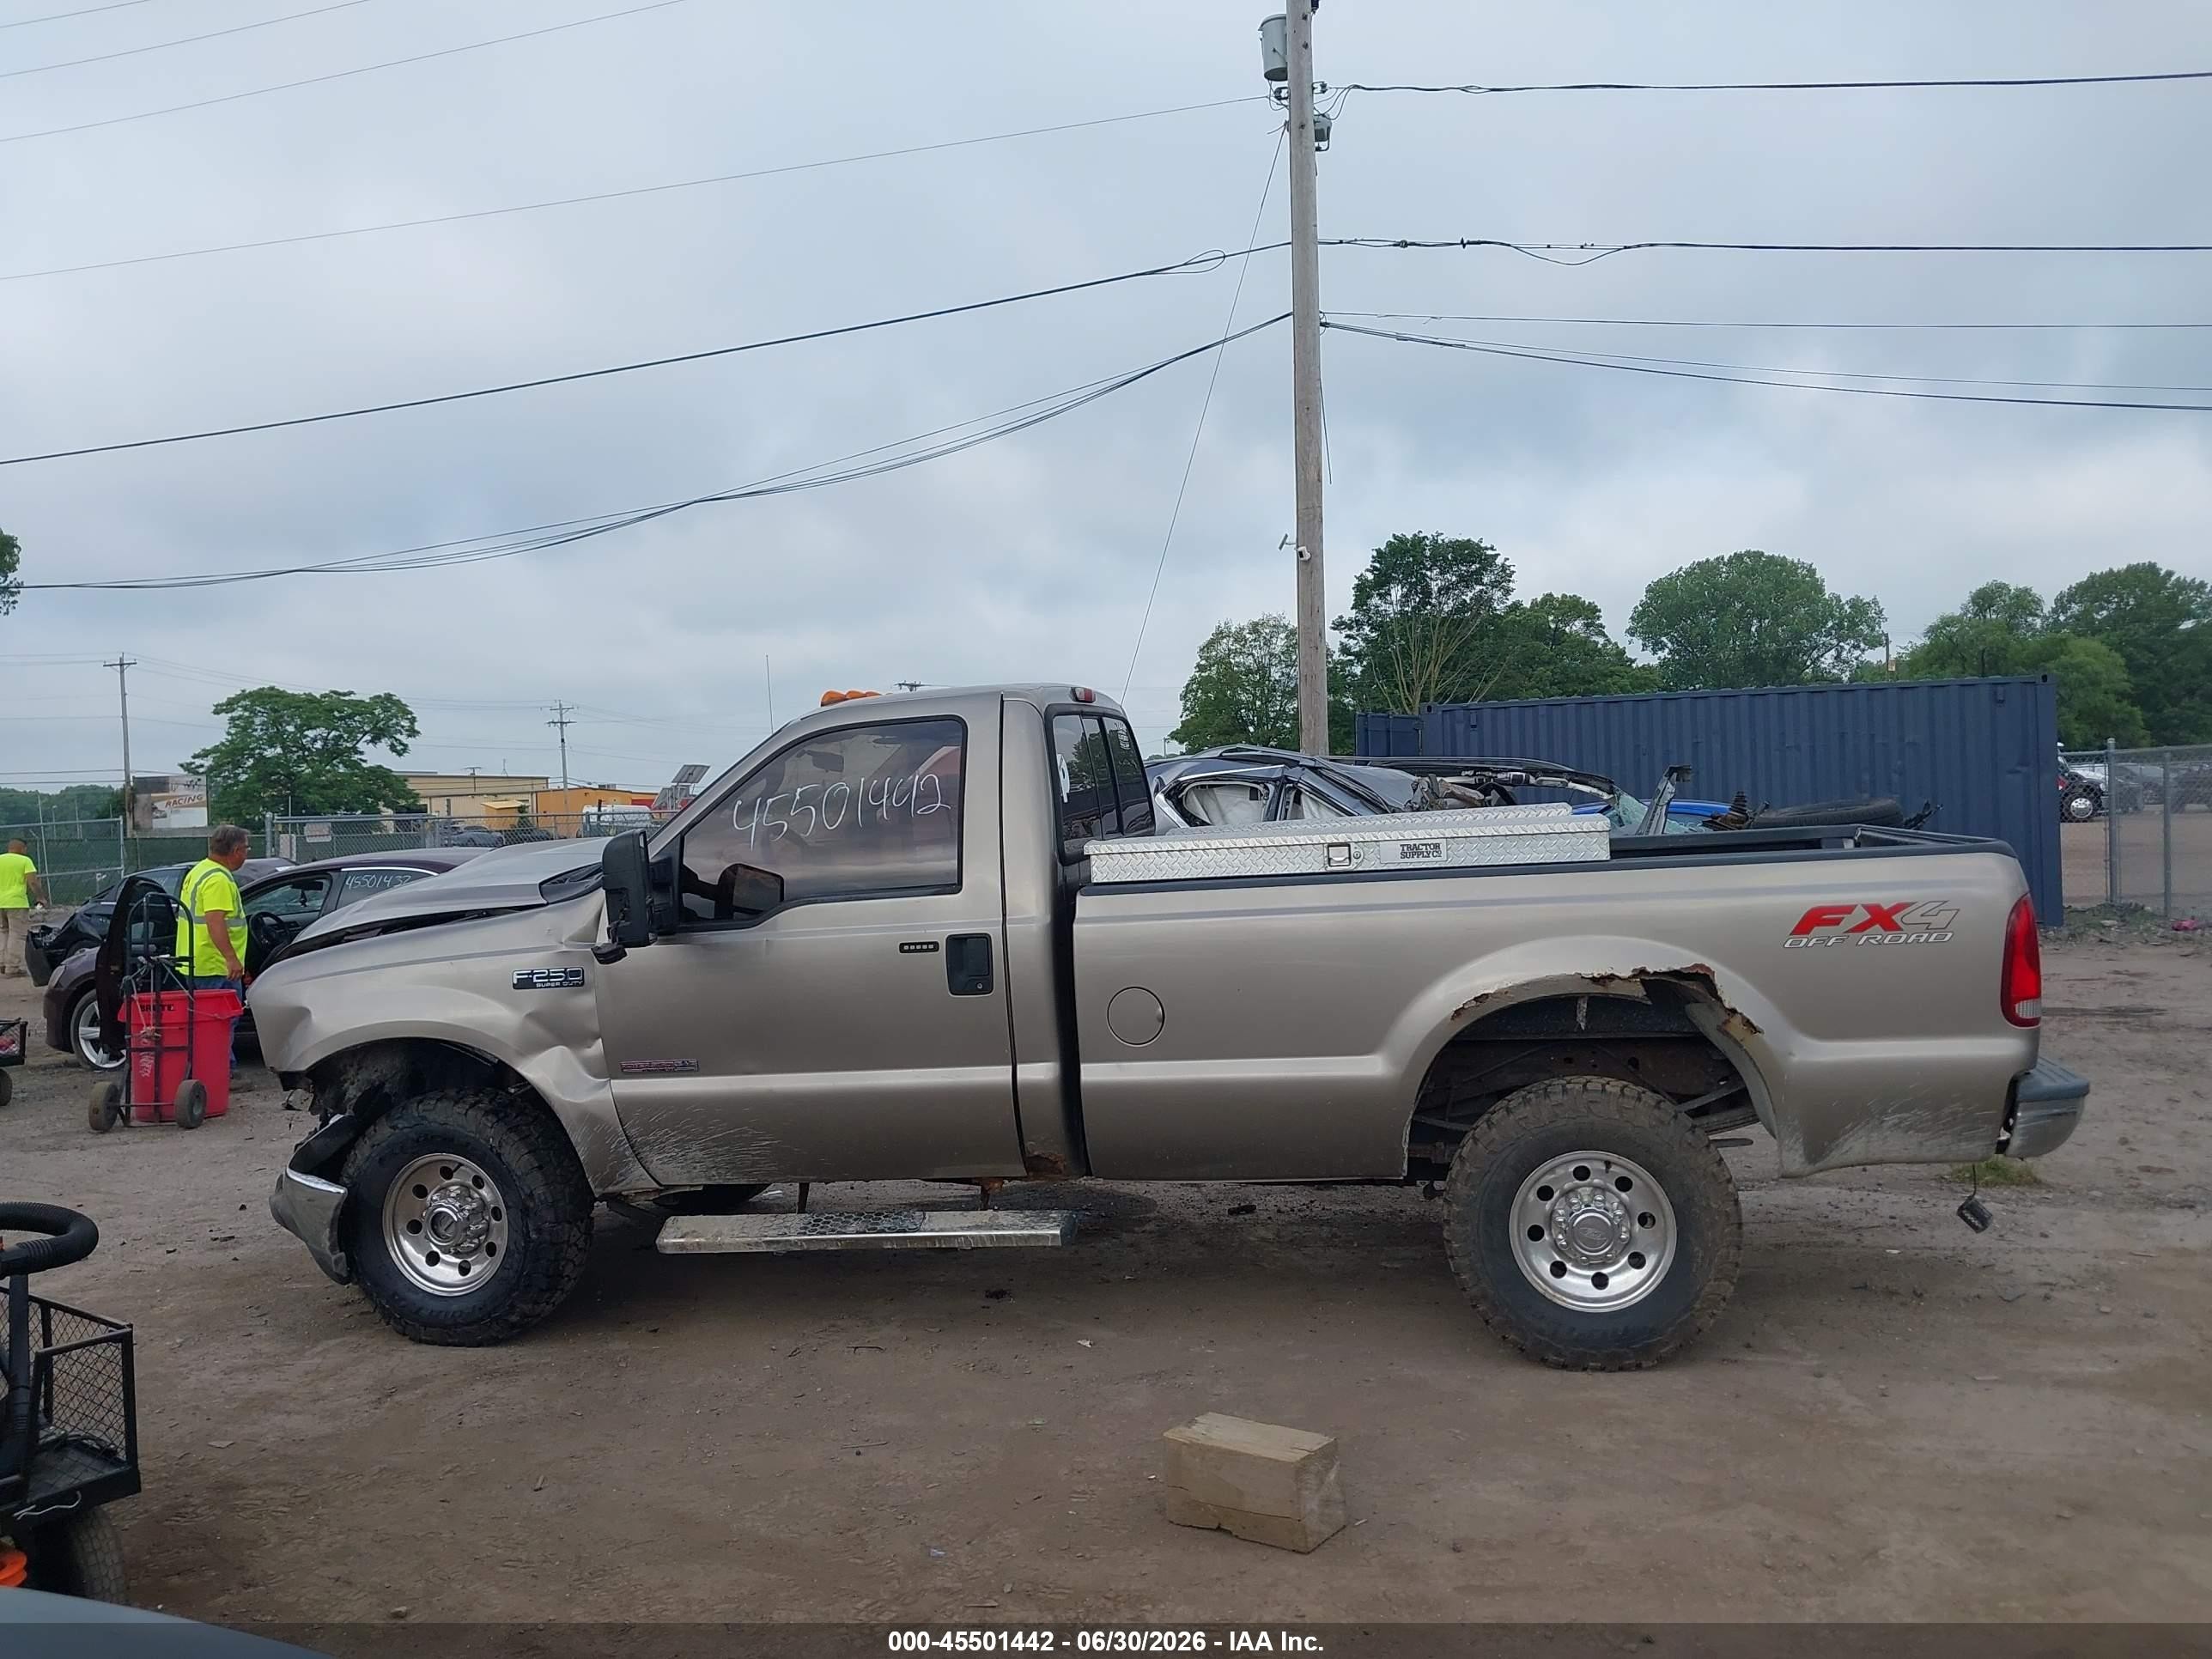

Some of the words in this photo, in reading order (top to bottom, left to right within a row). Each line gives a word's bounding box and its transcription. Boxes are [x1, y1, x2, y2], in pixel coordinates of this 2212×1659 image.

[165, 794, 204, 808] RACING
[732, 774, 951, 852] 45501442
[1400, 842, 1441, 851] TRACTOR
[1400, 851, 1431, 860] SUPPLY
[1790, 900, 1960, 936] FX4
[1784, 935, 1848, 949] OFF
[1856, 932, 1954, 946] ROAD
[513, 968, 584, 984] F-250
